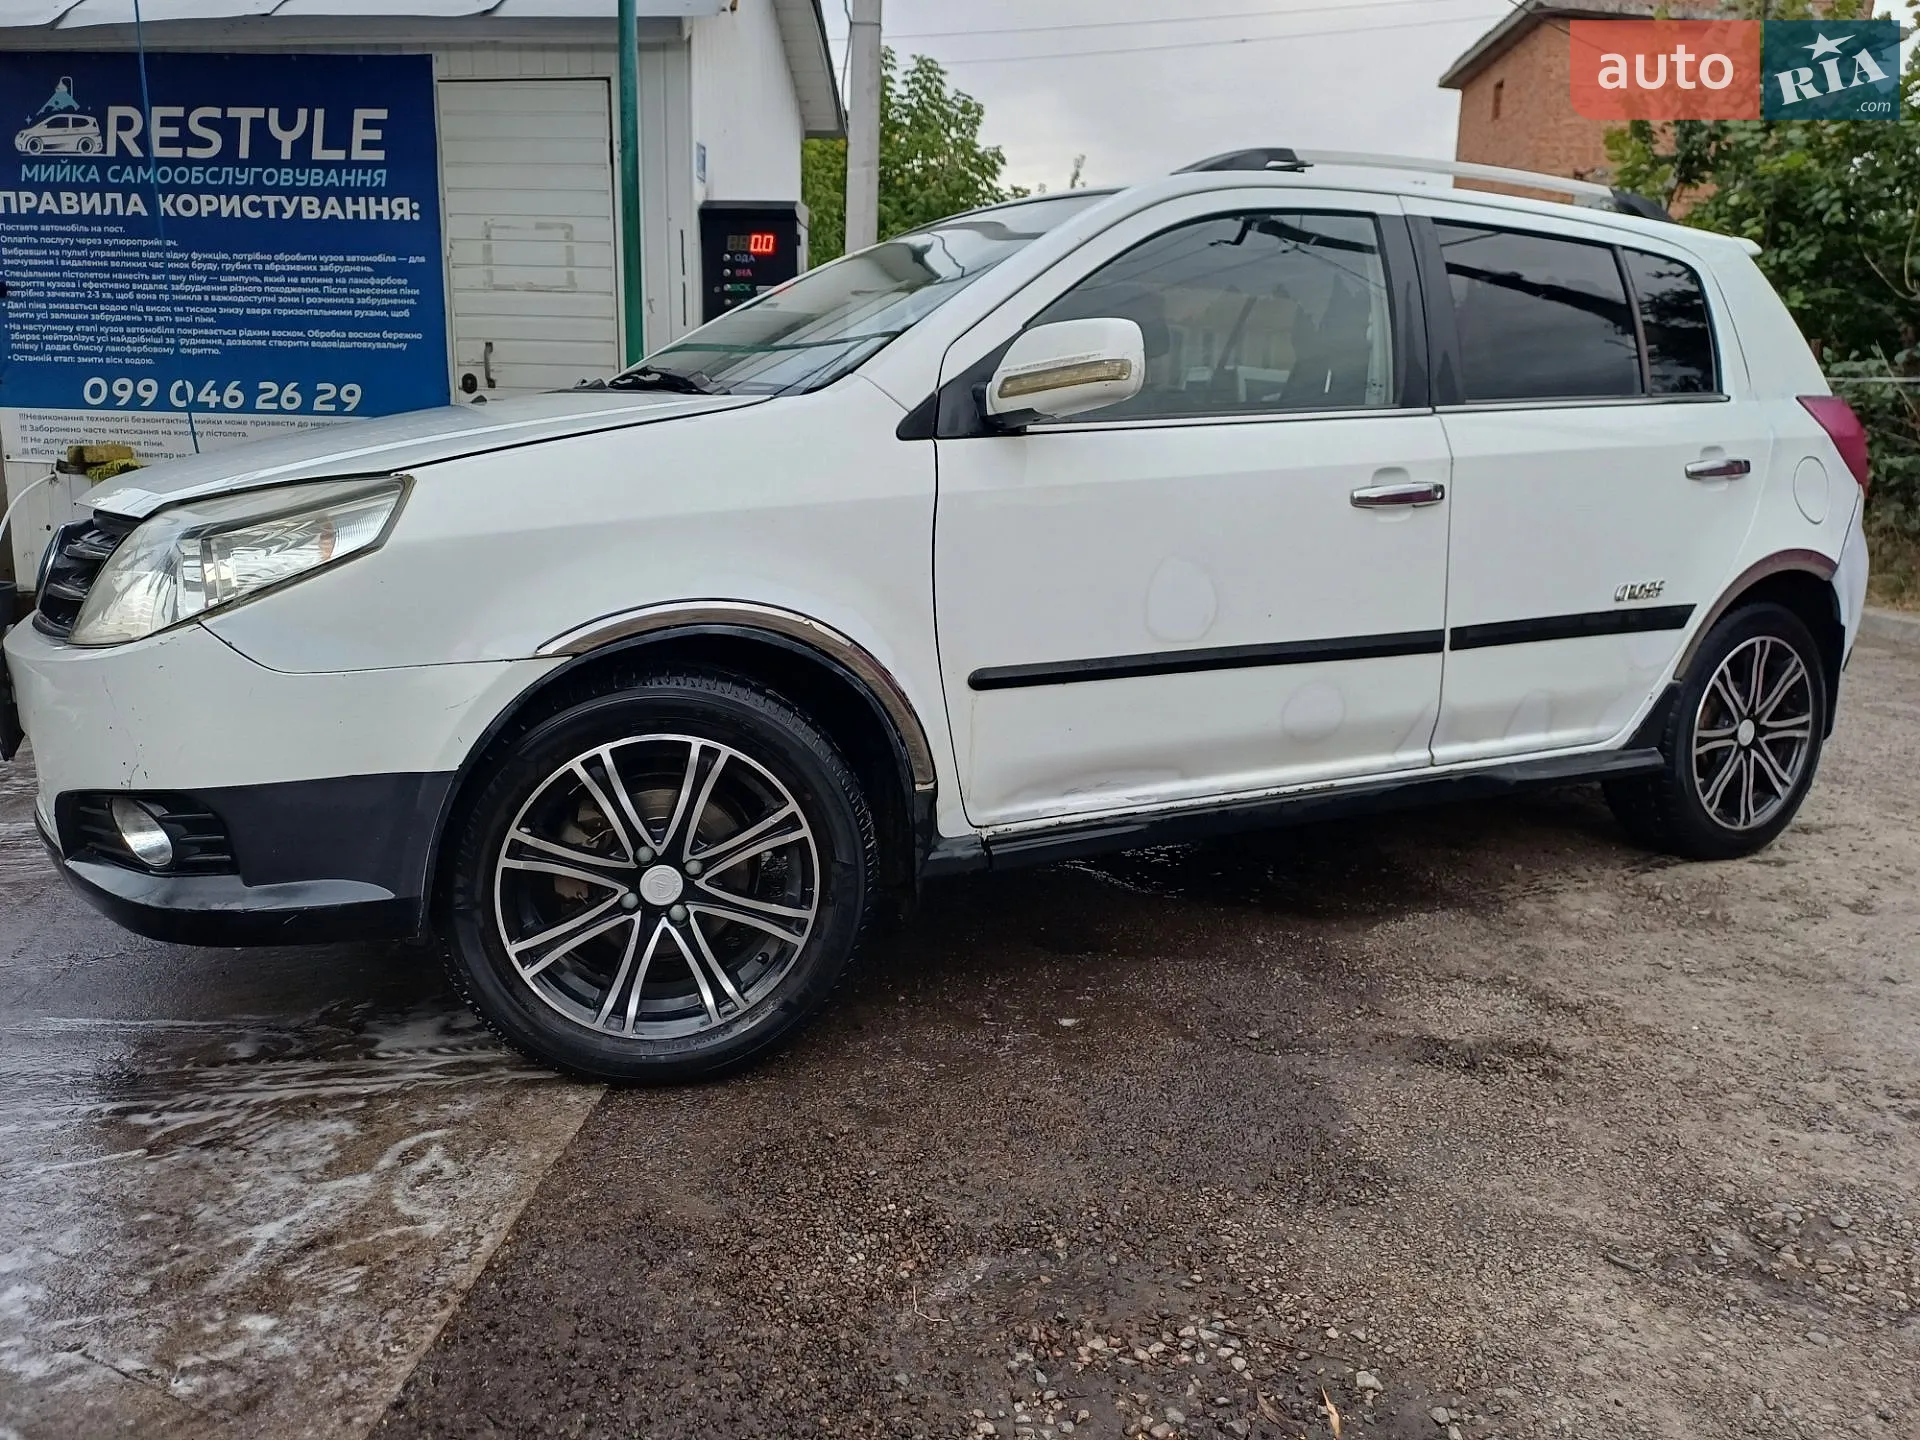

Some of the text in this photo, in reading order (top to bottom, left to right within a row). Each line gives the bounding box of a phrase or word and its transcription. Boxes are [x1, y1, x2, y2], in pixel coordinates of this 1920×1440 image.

[106, 105, 388, 161] RESTYLE
[21, 160, 387, 187] МИЙКА САМООБСЛУГОВУВАННЯ
[0, 191, 421, 221] ПРАВИЛА КОРИСТУВАННЯ:
[166, 337, 224, 347] заруднення,
[83, 376, 362, 413] 099 046 26 29
[132, 415, 192, 424] безконтактно
[174, 429, 203, 438] кноку
